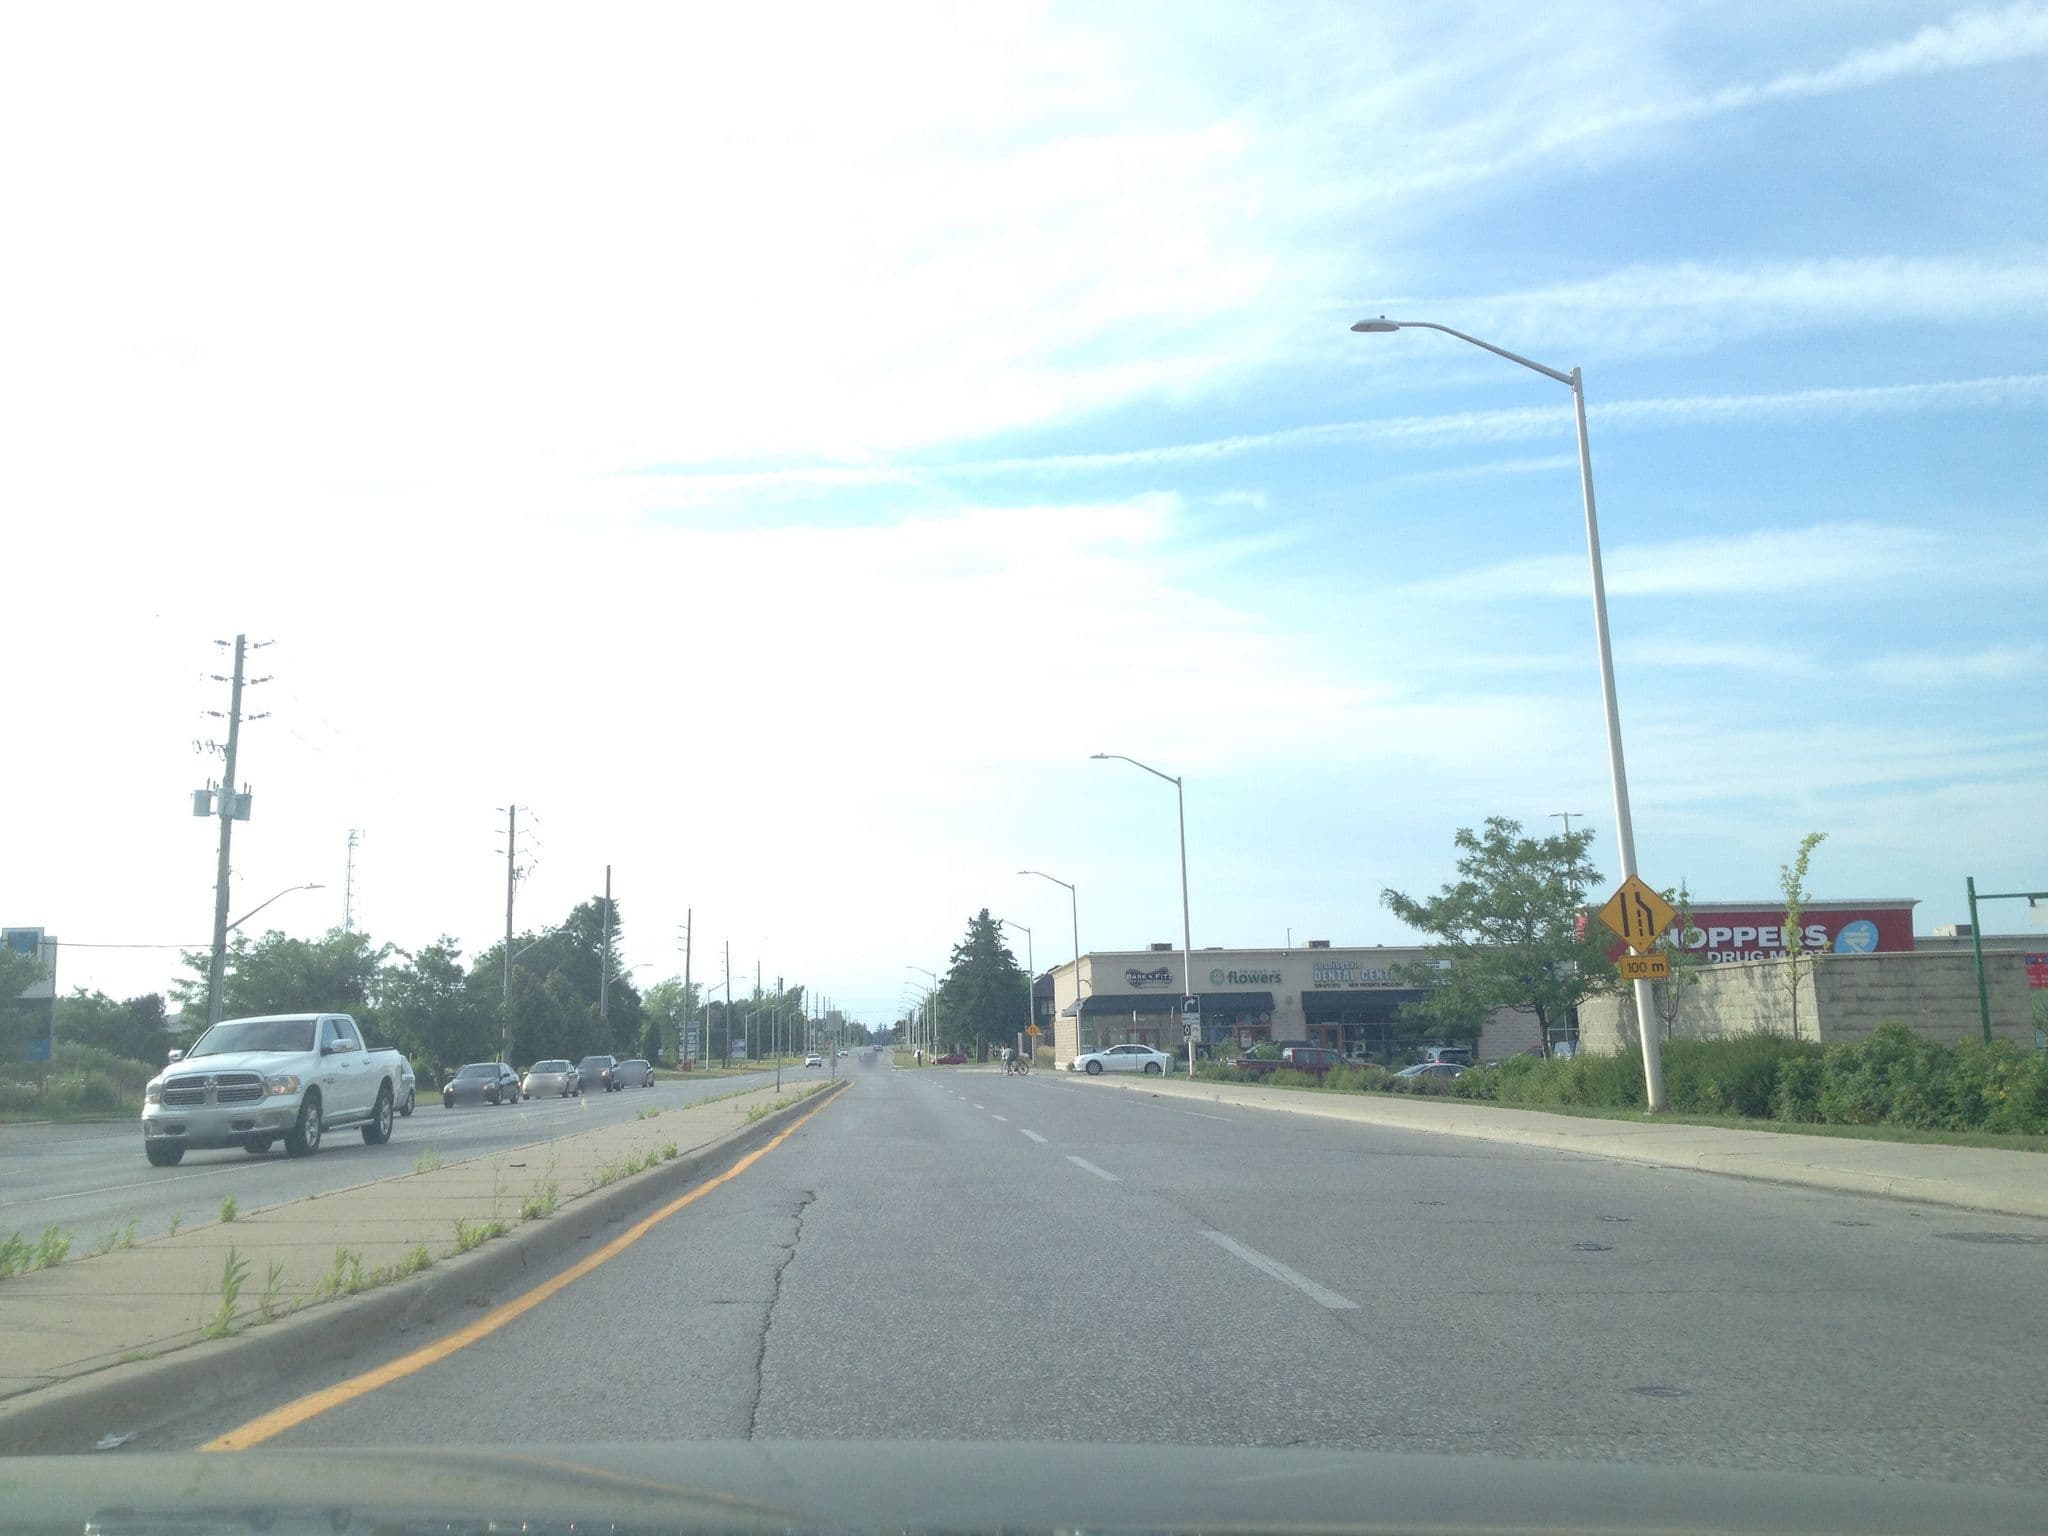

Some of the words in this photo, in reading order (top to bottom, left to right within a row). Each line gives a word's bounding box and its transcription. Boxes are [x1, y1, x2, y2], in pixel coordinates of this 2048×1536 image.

[1656, 924, 1828, 948] HOPPERS
[1708, 951, 1764, 963] DRUG
[1626, 961, 1648, 974] 100
[1652, 962, 1665, 972] m
[1228, 970, 1282, 984] flowers
[1314, 969, 1356, 982] DENTAL
[1360, 969, 1398, 982] CENT
